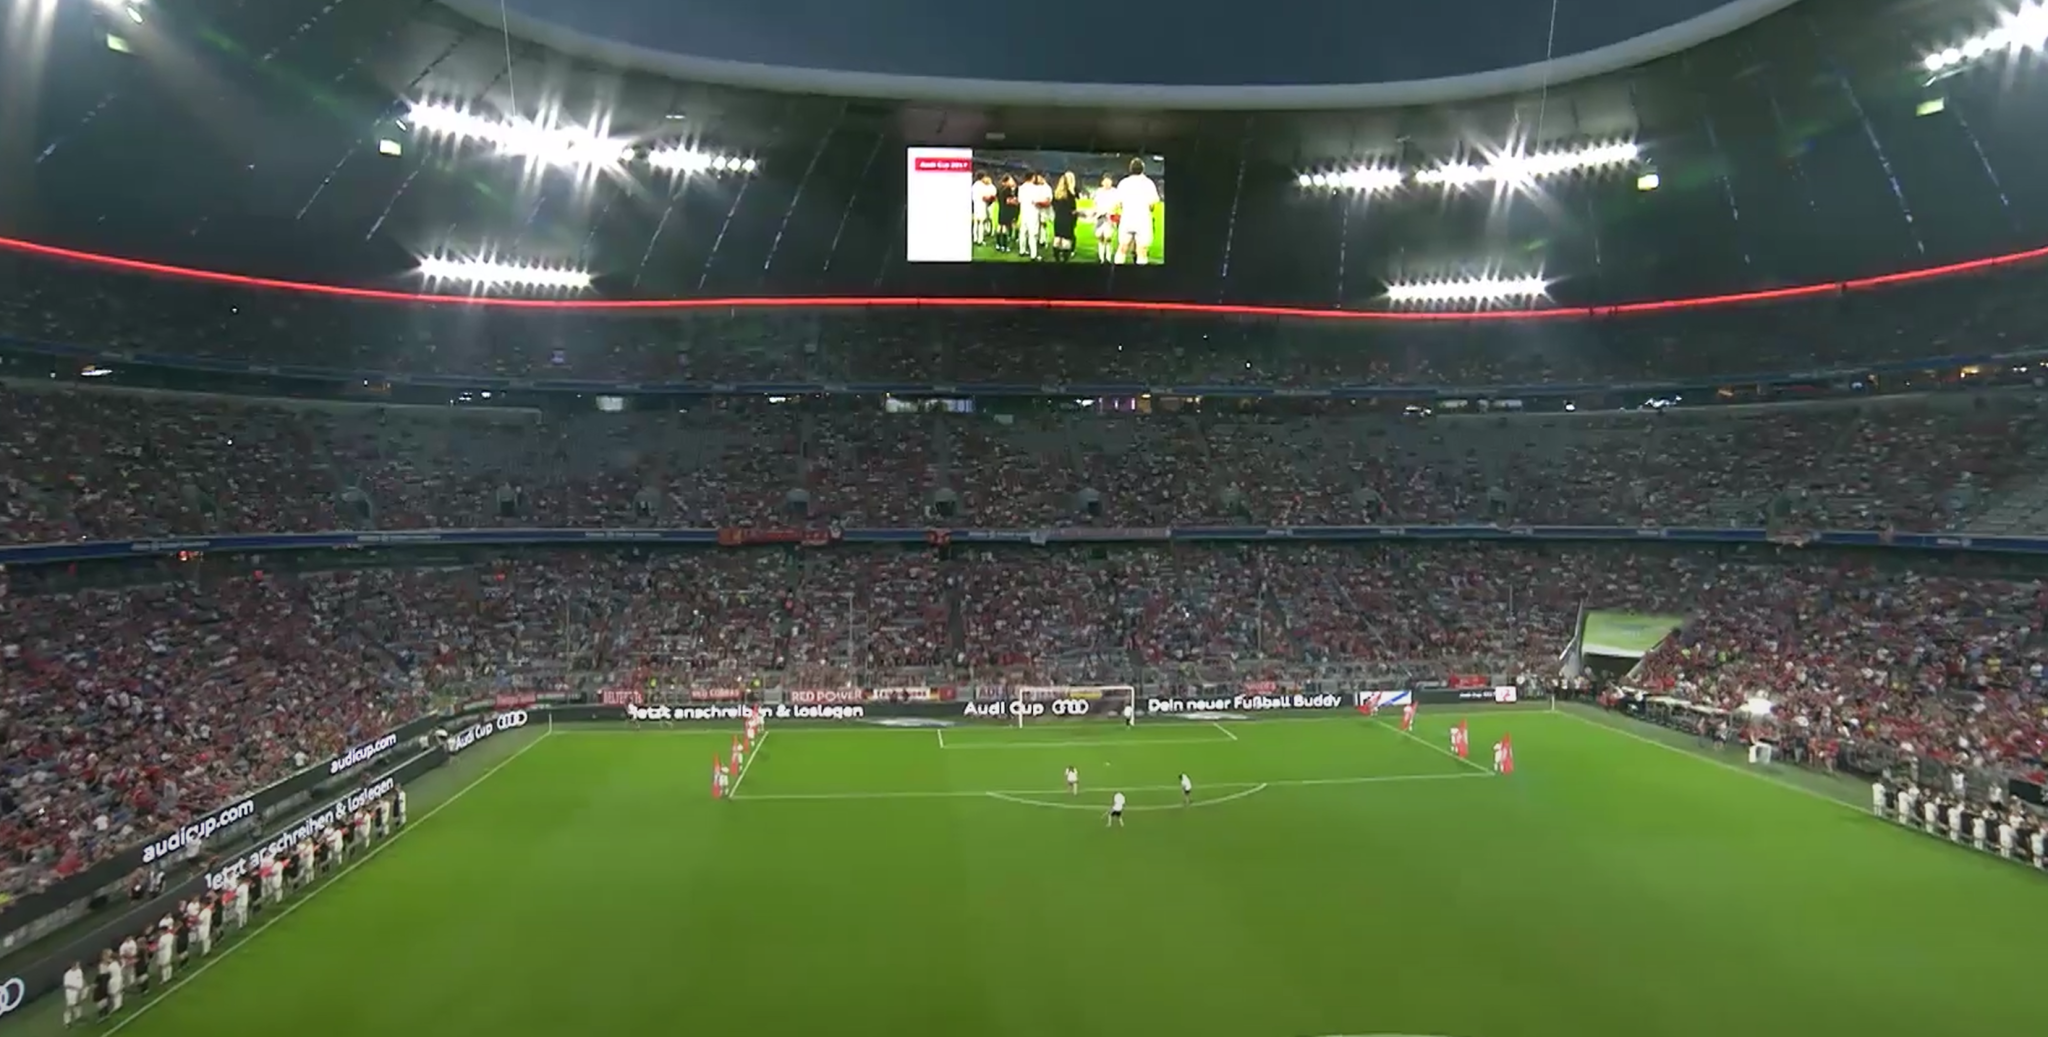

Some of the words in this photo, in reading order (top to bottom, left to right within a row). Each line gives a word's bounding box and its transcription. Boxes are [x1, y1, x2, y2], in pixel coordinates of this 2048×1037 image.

[791, 690, 815, 703] RED
[816, 688, 862, 702] POWER
[1148, 698, 1184, 712] Dein
[1186, 699, 1232, 711] neuer
[1234, 694, 1291, 710] Fußball
[1293, 693, 1341, 708] Buddy
[793, 704, 864, 719] loslegen
[963, 701, 1006, 715] Audi
[1008, 701, 1045, 716] Cup
[454, 729, 475, 751] Audi
[475, 722, 494, 740] Cup
[329, 732, 397, 774] audicup.com
[142, 799, 255, 863] audicup.com
